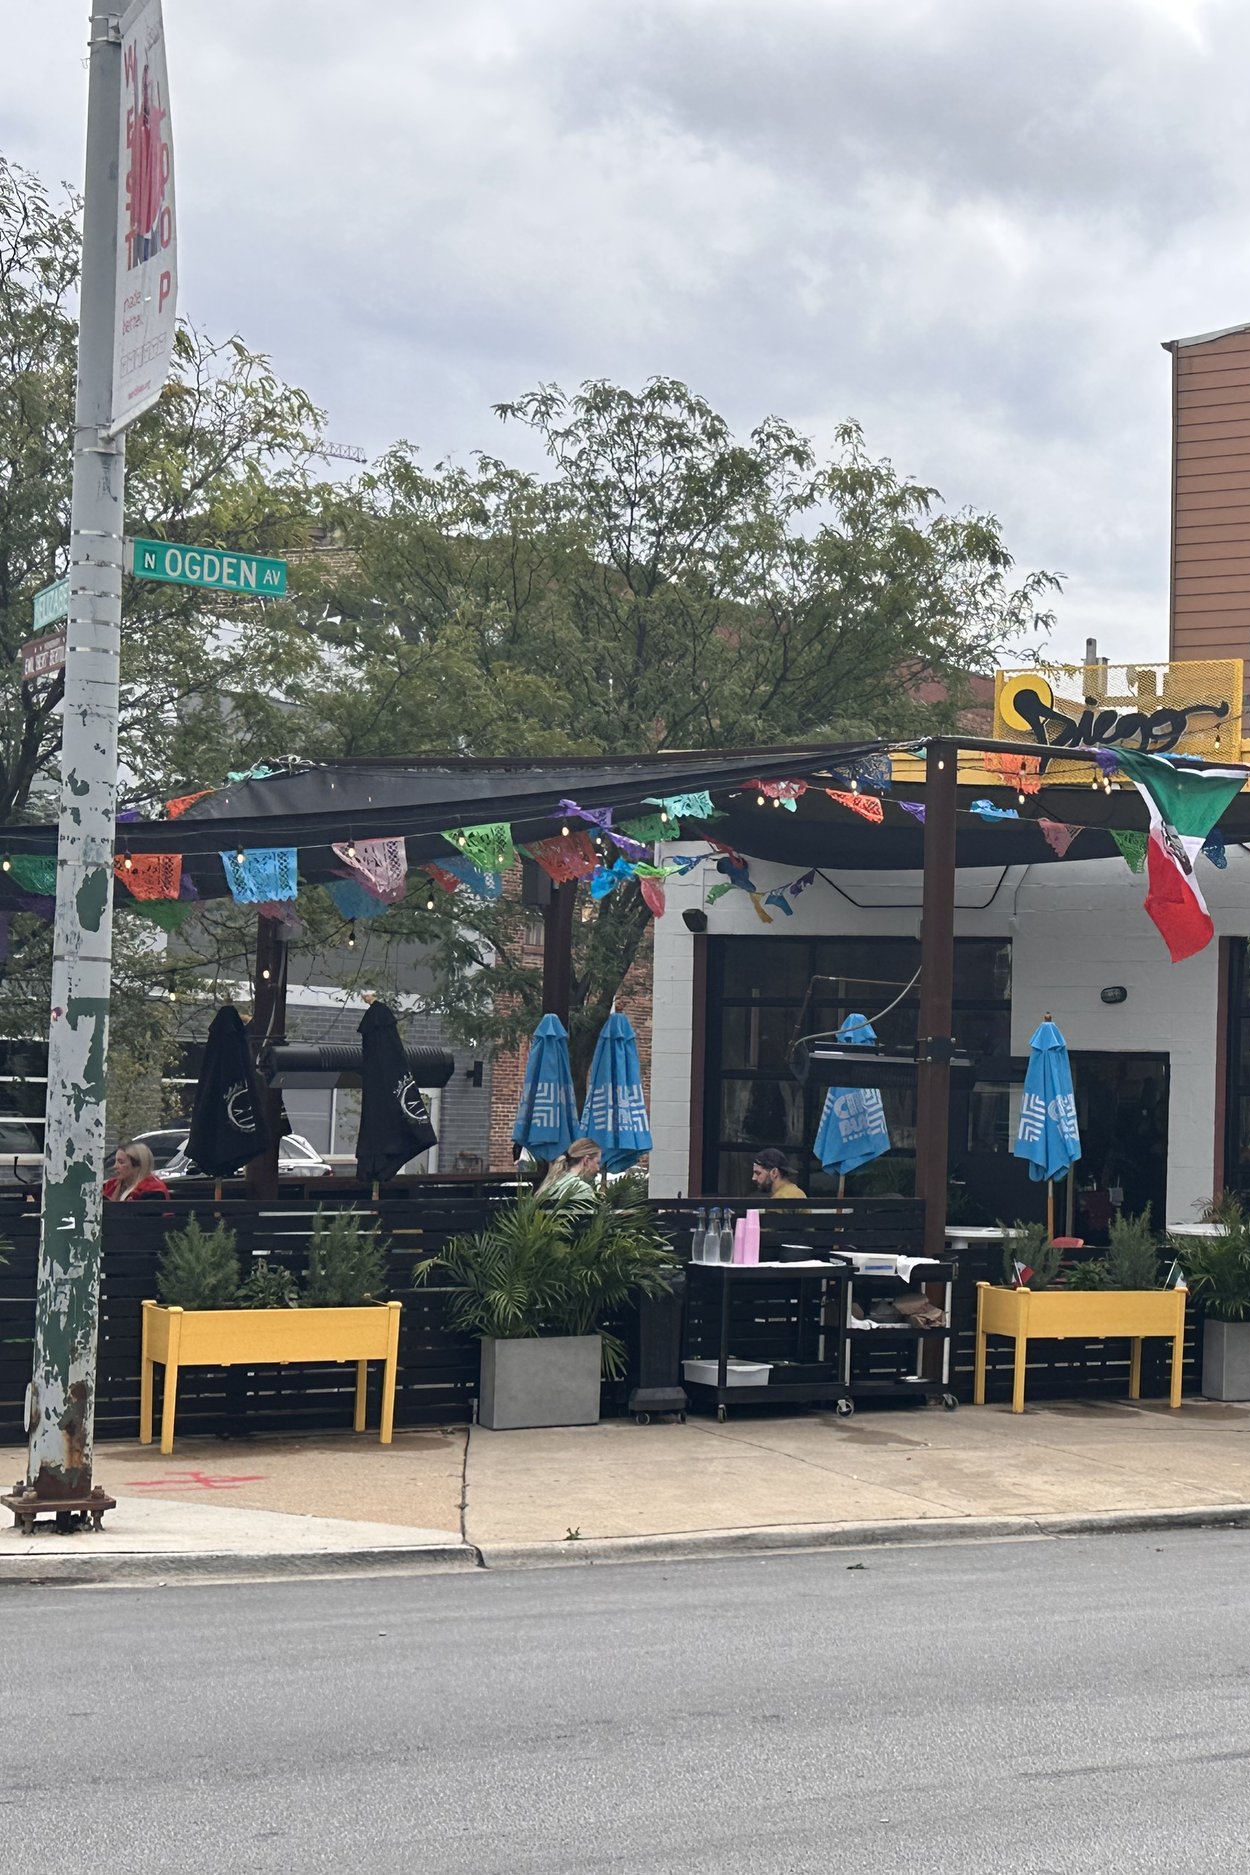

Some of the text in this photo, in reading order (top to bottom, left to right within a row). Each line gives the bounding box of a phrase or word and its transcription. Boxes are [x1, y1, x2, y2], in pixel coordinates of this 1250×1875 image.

[144, 548, 281, 589] N OGDEN AV
[1012, 687, 1231, 776] Diego
